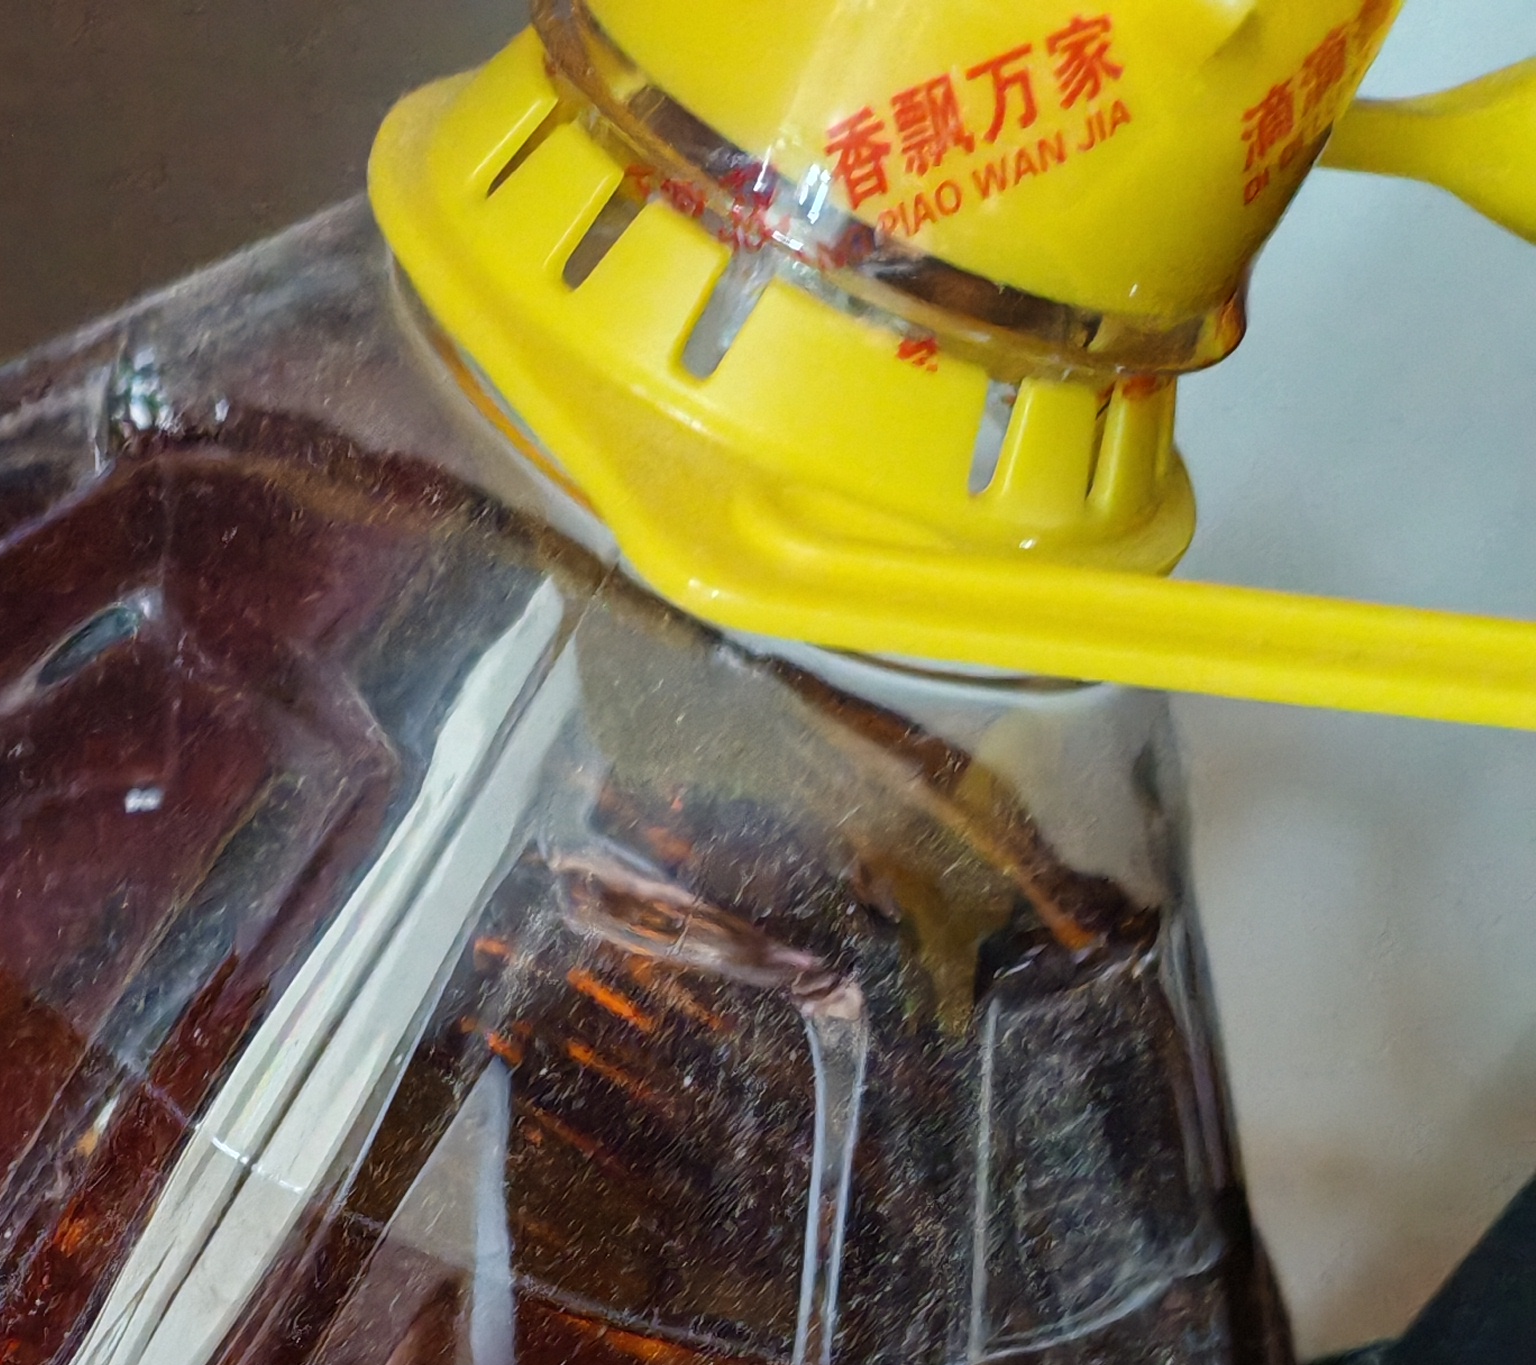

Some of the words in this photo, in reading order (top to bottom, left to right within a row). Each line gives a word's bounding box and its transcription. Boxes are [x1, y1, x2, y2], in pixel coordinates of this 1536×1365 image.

[824, 14, 1124, 211] 香飘万家
[971, 130, 1068, 201] WAN
[1077, 98, 1132, 153] JIA
